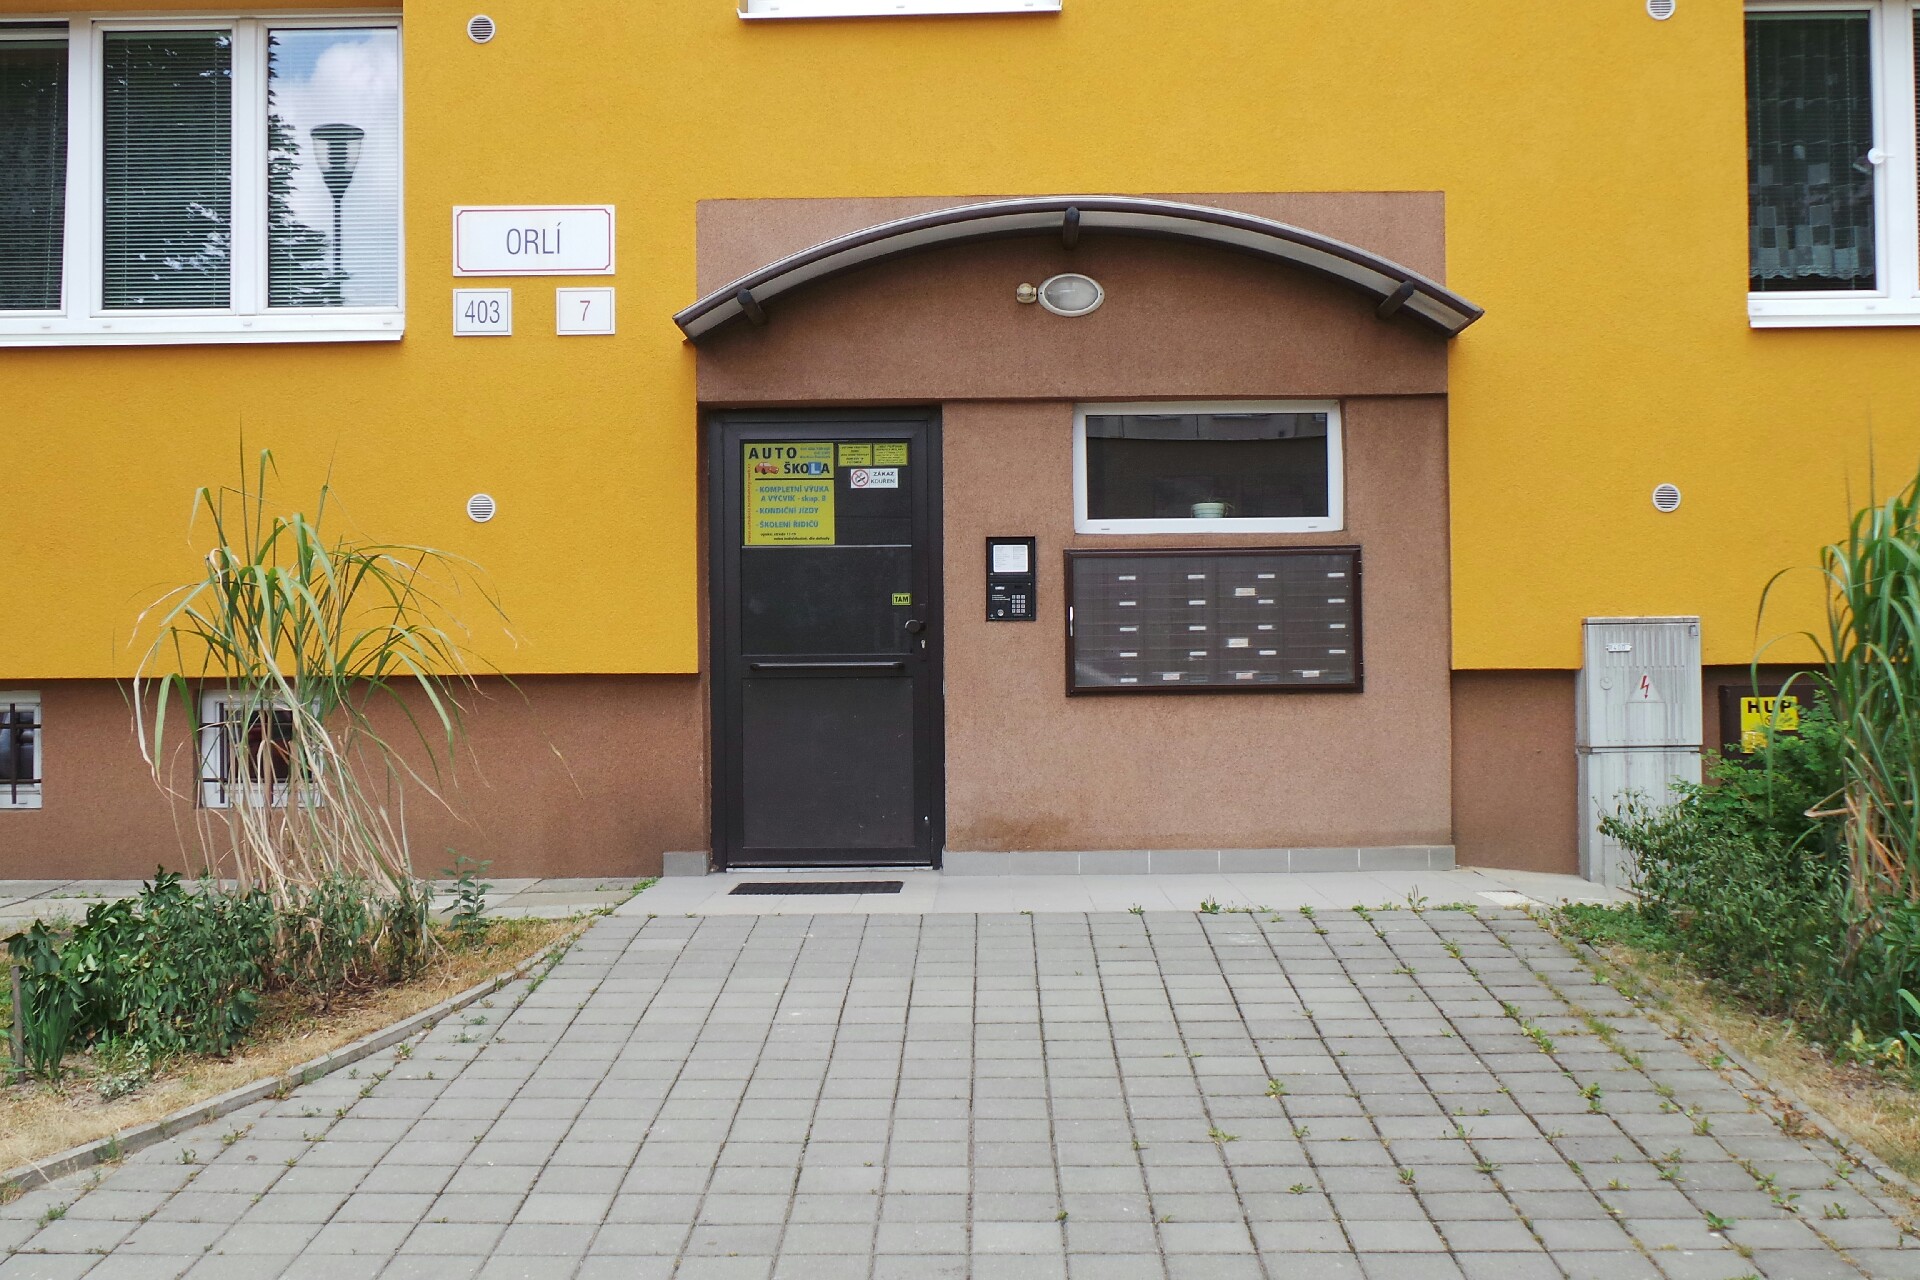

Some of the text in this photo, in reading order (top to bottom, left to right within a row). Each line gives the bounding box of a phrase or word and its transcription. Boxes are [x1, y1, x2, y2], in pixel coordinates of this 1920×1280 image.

[506, 222, 562, 255] ORLÍ
[464, 300, 500, 323] 403
[579, 300, 591, 321] 7
[748, 447, 798, 459] AUTO
[783, 461, 830, 475] ŠKOLA
[759, 484, 830, 493] KOMPLETNÍ VÝUKA
[761, 494, 766, 502] A
[767, 494, 796, 502] VÝCVIK
[759, 520, 791, 528] ŠKOLENÍ
[1747, 700, 1791, 713] HUP
